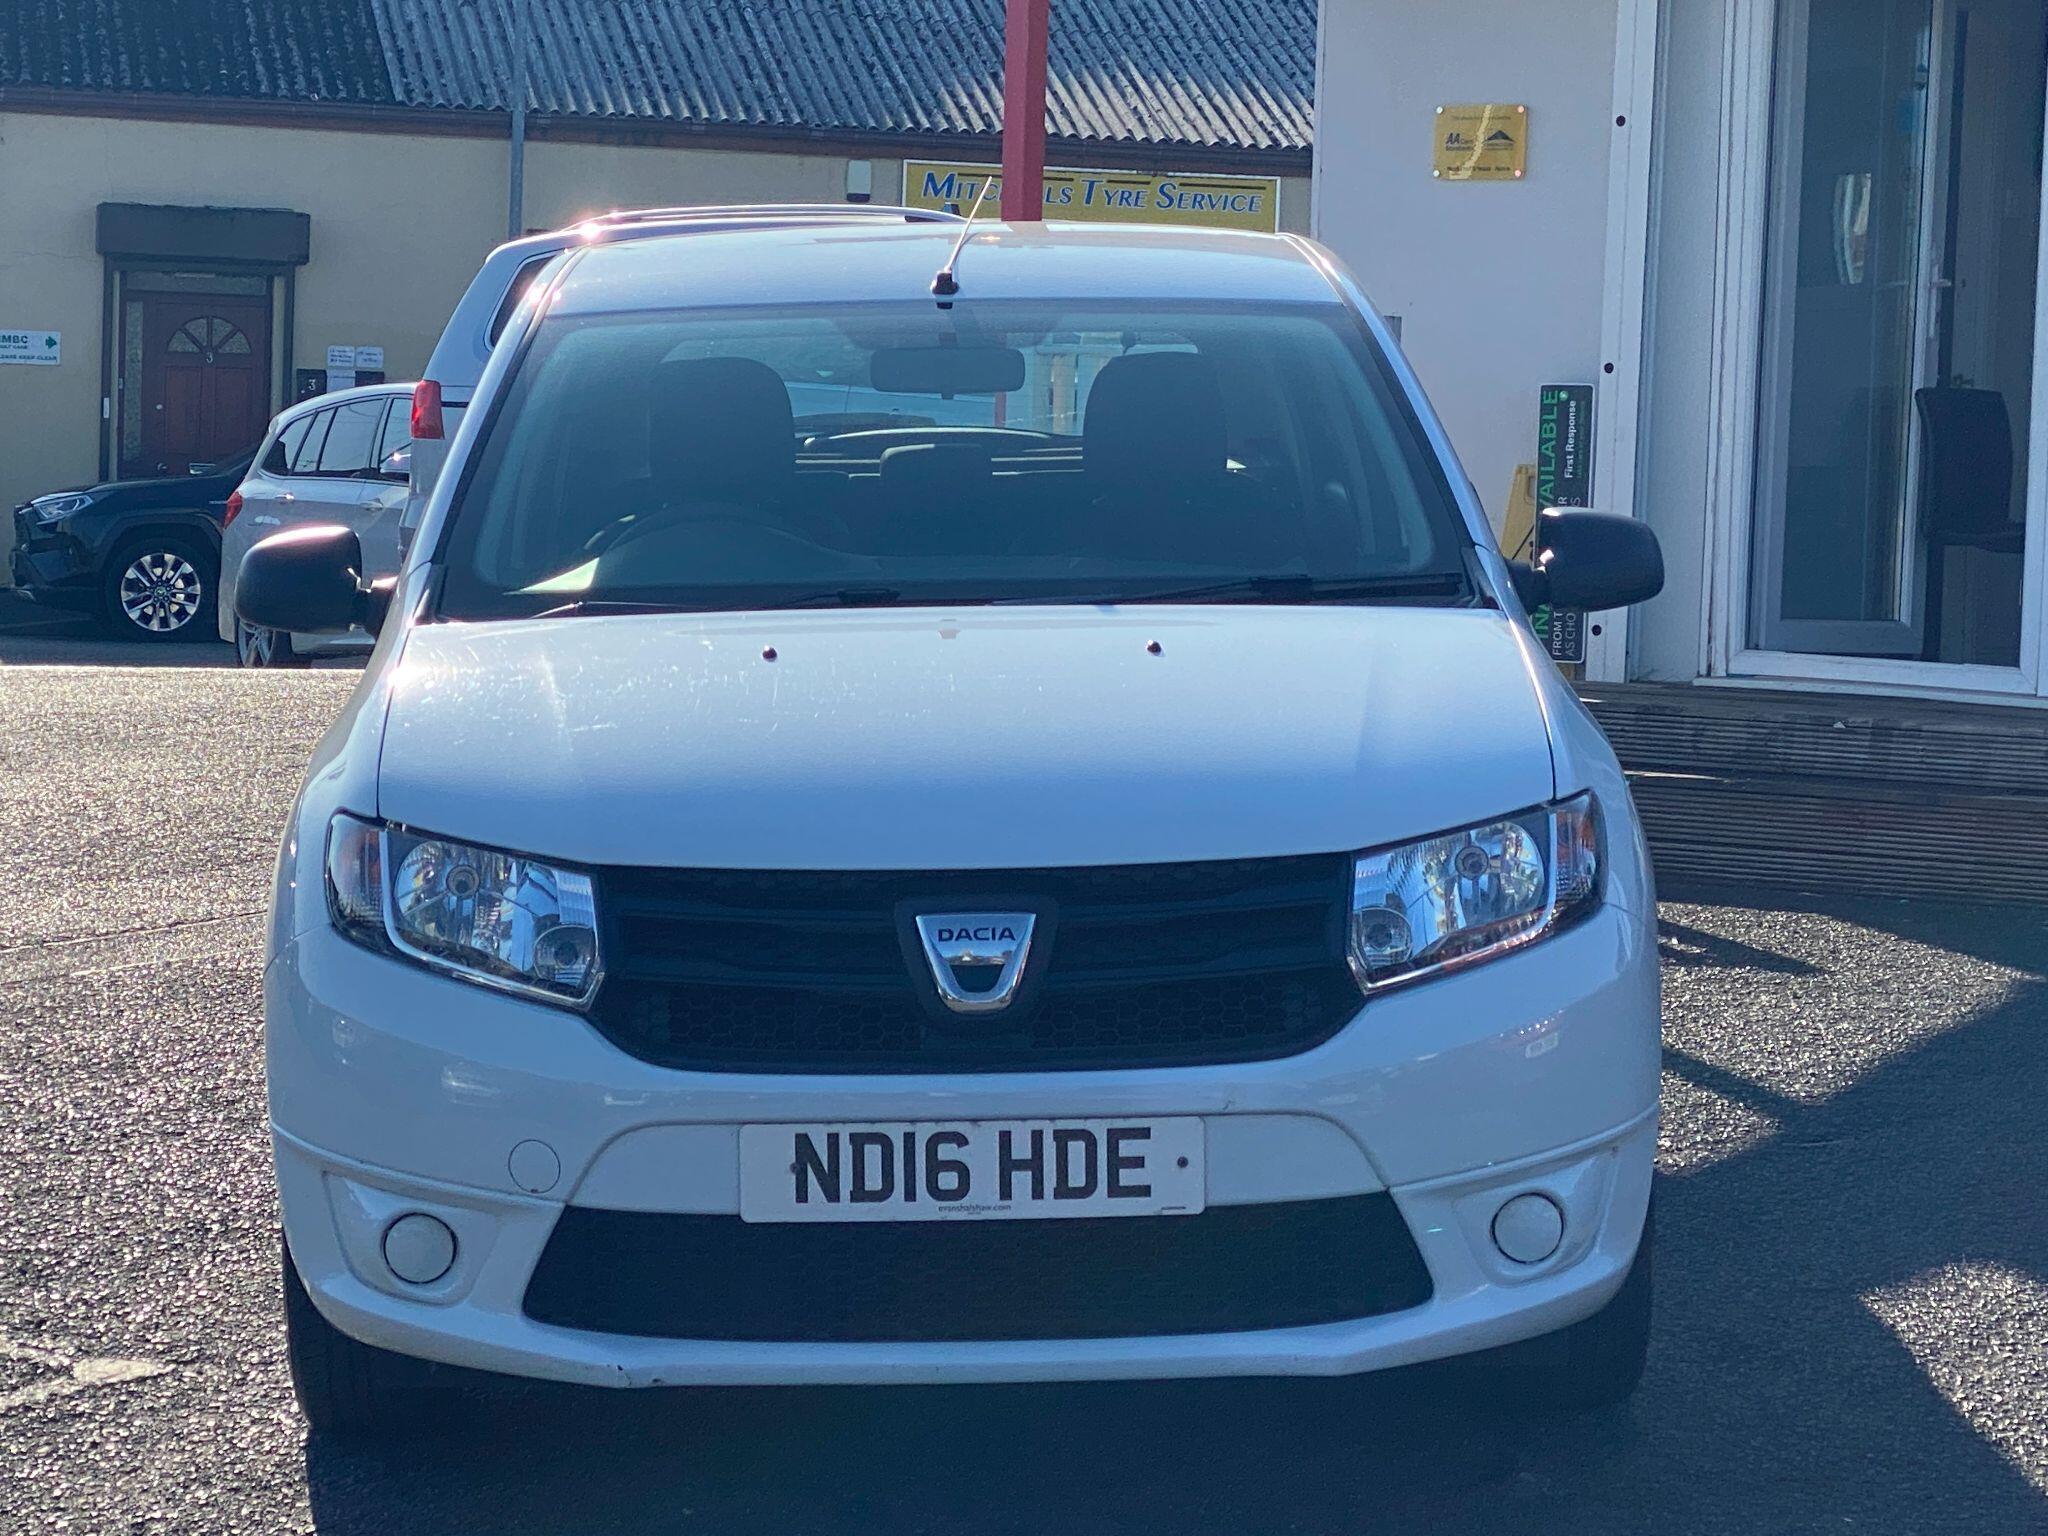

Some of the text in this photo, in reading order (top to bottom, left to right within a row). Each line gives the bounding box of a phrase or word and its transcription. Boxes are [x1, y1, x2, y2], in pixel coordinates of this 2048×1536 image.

[923, 172, 1263, 213] MITCLS TYRE SERVICE
[0, 334, 28, 344] MBC
[308, 379, 316, 391] 3
[1564, 400, 1578, 479] First Response
[1552, 621, 1563, 656] FROM
[1565, 641, 1576, 657] AS
[937, 927, 1016, 942] DACIA
[794, 1127, 1152, 1204] ND16 HDE
